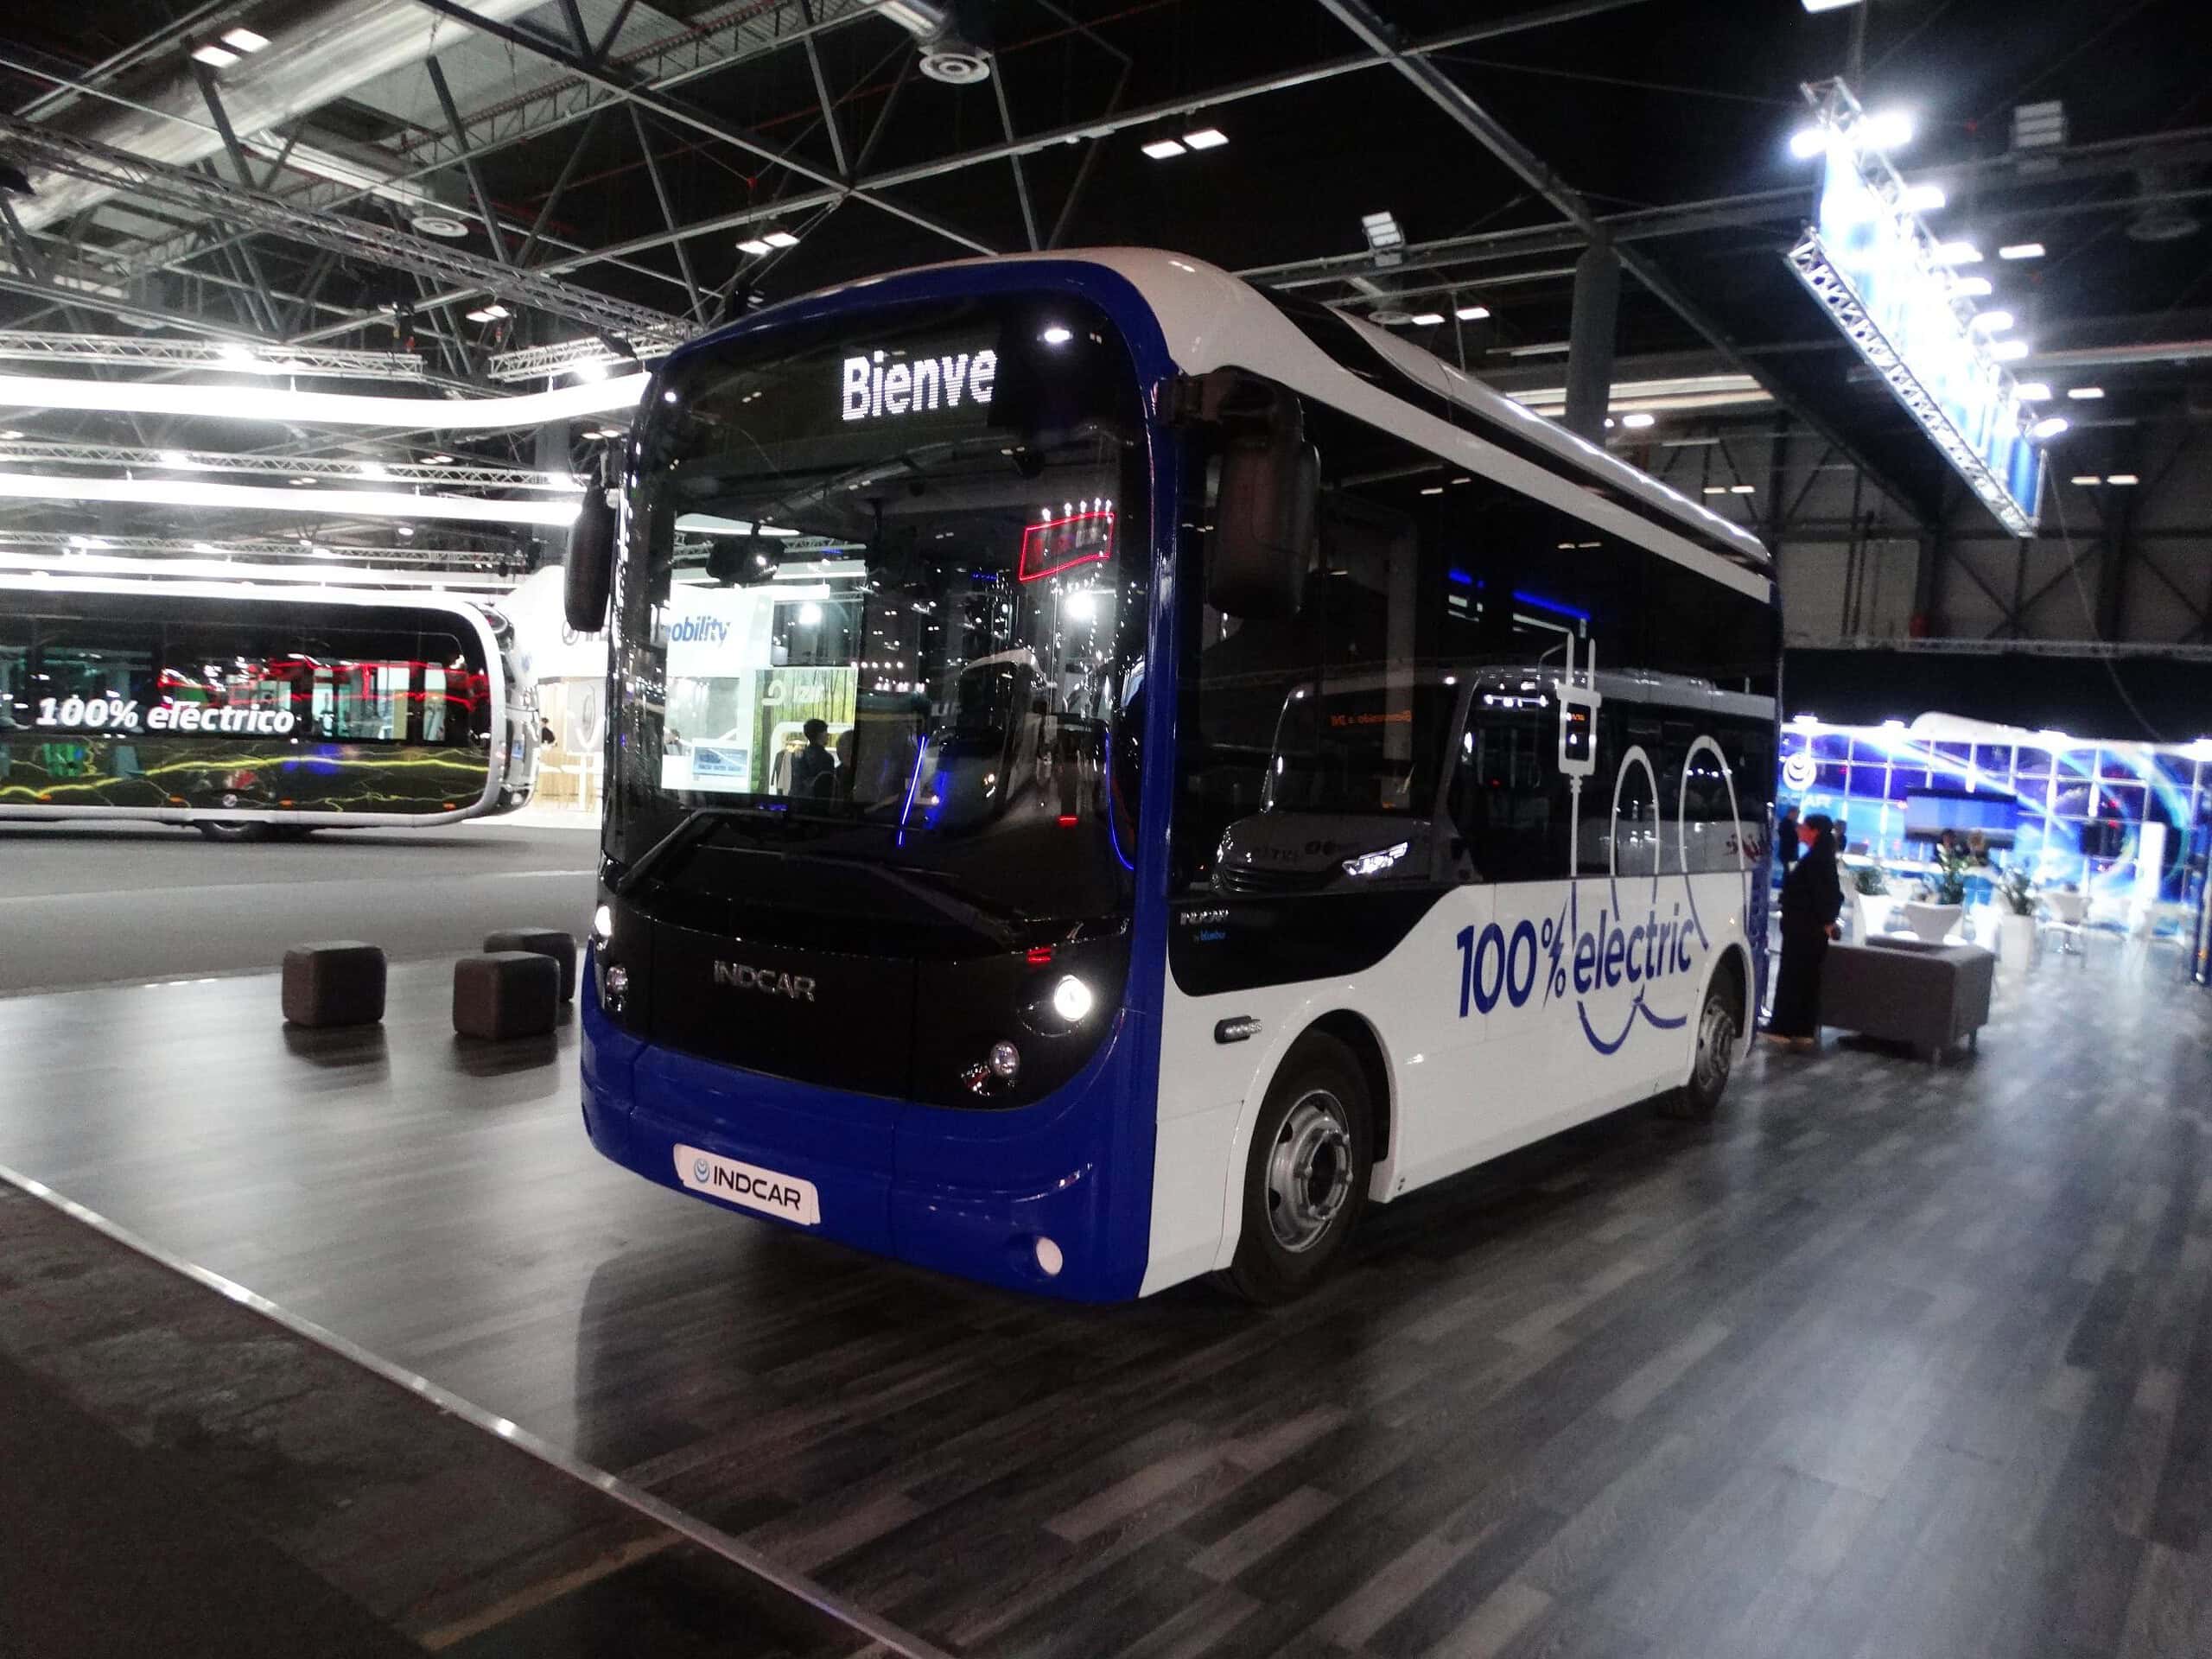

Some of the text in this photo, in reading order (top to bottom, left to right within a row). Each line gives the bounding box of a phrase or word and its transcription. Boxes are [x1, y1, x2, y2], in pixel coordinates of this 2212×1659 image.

[842, 350, 998, 420] Bienve
[35, 696, 139, 728] 100%
[713, 959, 815, 1002] INDCAR
[1457, 899, 1694, 1018] 100% electric
[713, 1165, 802, 1211] INDCAR
